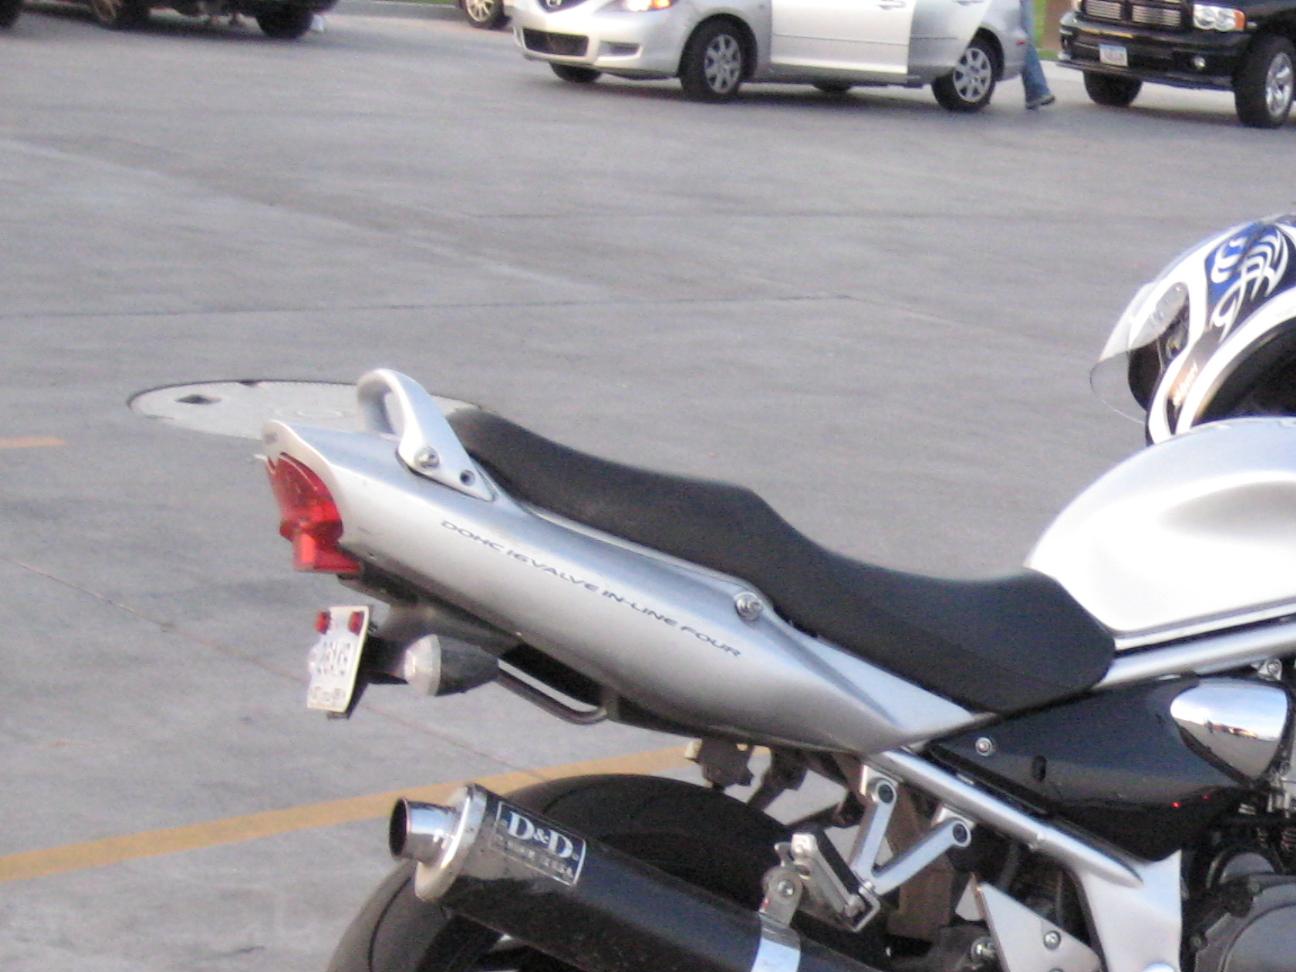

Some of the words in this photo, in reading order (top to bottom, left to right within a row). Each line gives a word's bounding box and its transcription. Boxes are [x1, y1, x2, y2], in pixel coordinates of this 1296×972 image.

[441, 519, 504, 551] DOHC
[680, 625, 742, 657] FOUR
[508, 811, 573, 859] D&D
